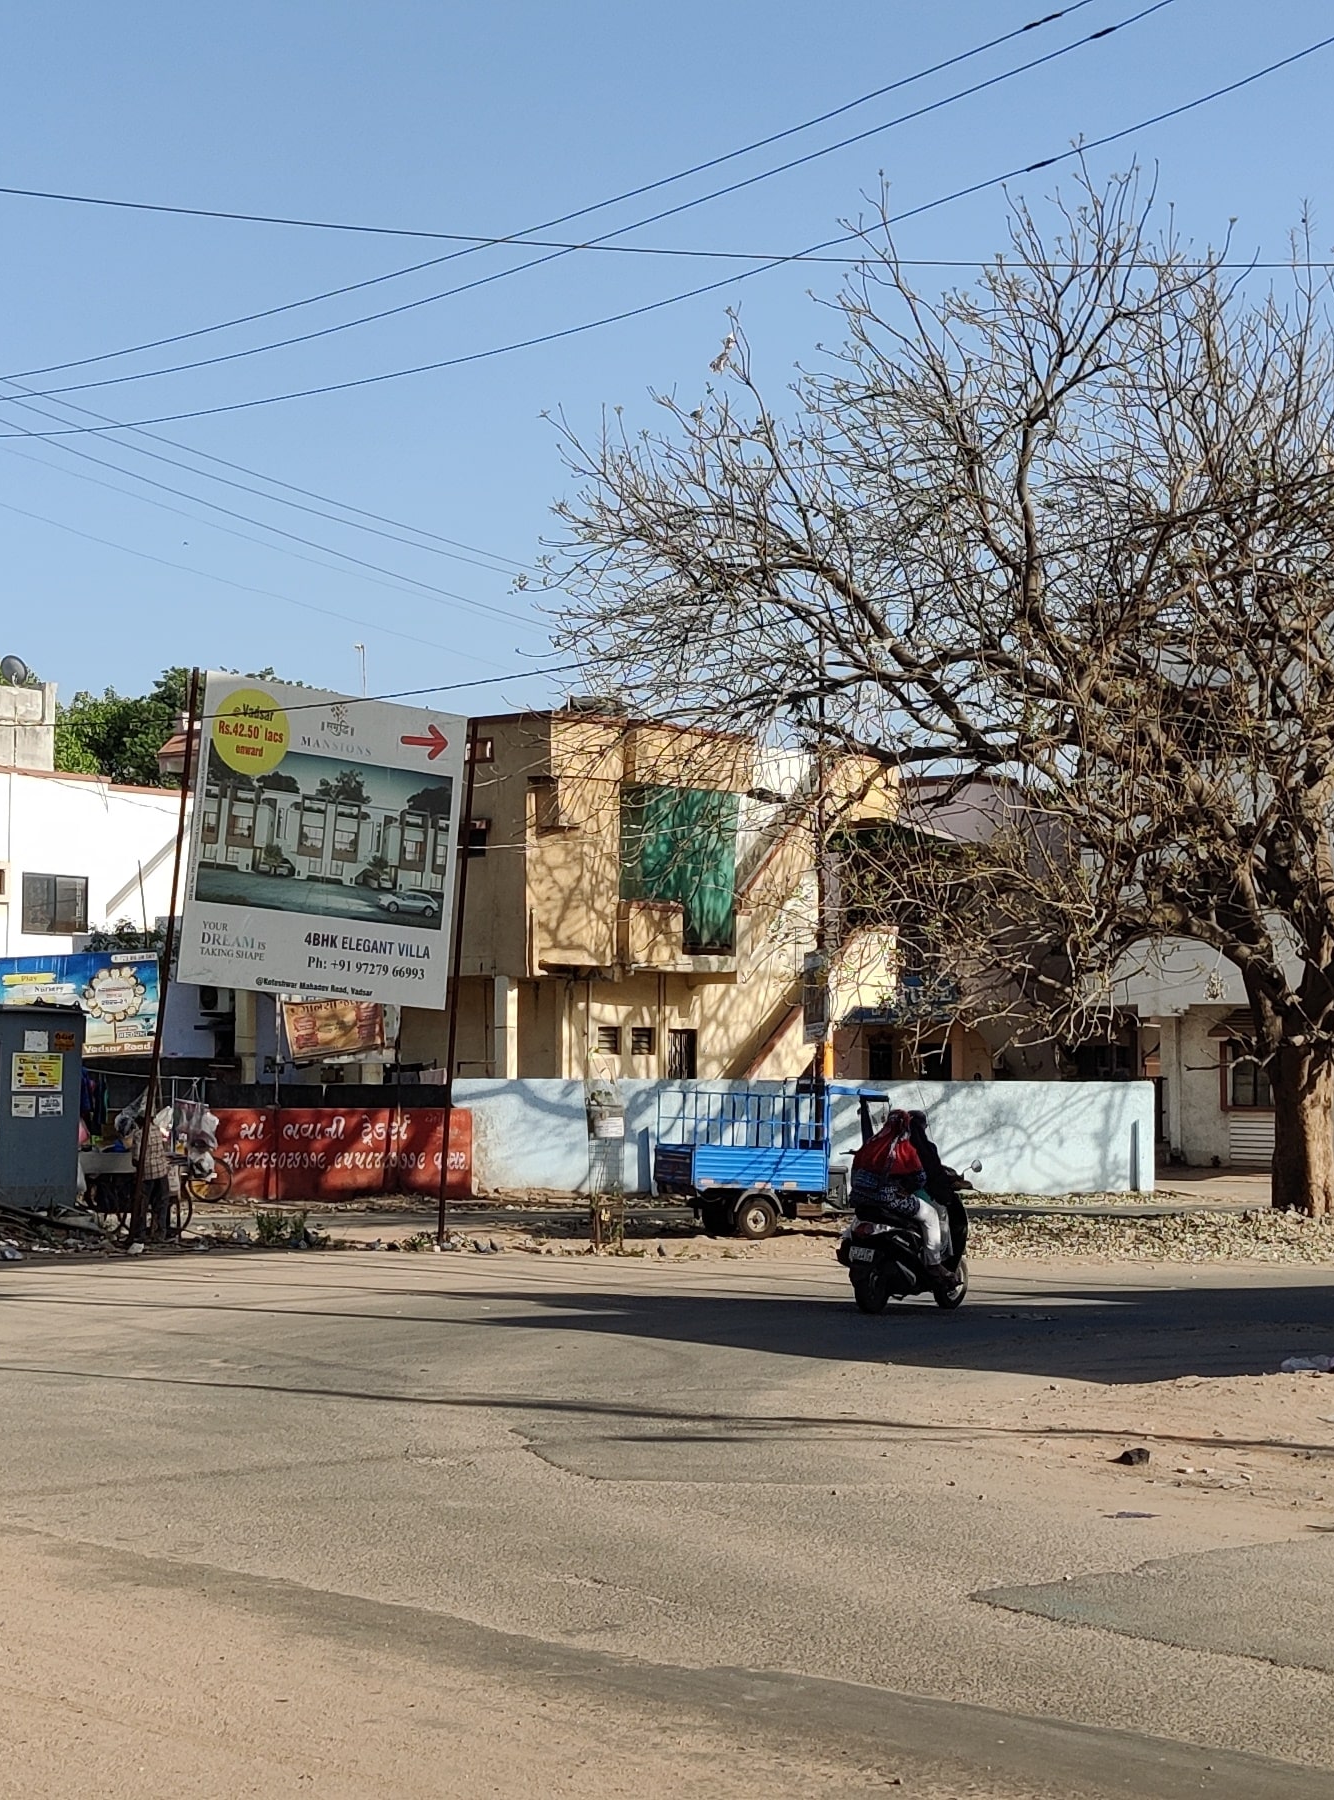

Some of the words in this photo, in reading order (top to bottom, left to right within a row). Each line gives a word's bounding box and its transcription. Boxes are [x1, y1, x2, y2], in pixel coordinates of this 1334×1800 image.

[265, 727, 284, 744] lacs
[235, 744, 264, 758] onward
[301, 736, 372, 757] MANSIONS
[202, 920, 228, 932] YOUR
[201, 931, 255, 949] DREAM
[257, 941, 267, 951] IS
[304, 932, 338, 949] 4BHK
[341, 936, 395, 956] ELEGANT
[397, 942, 430, 960] VILLA
[200, 946, 234, 958] TAKING
[235, 949, 266, 961] SHAPE
[307, 956, 328, 970] Ph:
[330, 959, 351, 973] +91
[355, 962, 389, 977] 97279
[392, 966, 425, 981] 66993
[350, 987, 373, 997] Vadsar
[240, 1115, 267, 1140] માં
[282, 1116, 346, 1140] ભવાની
